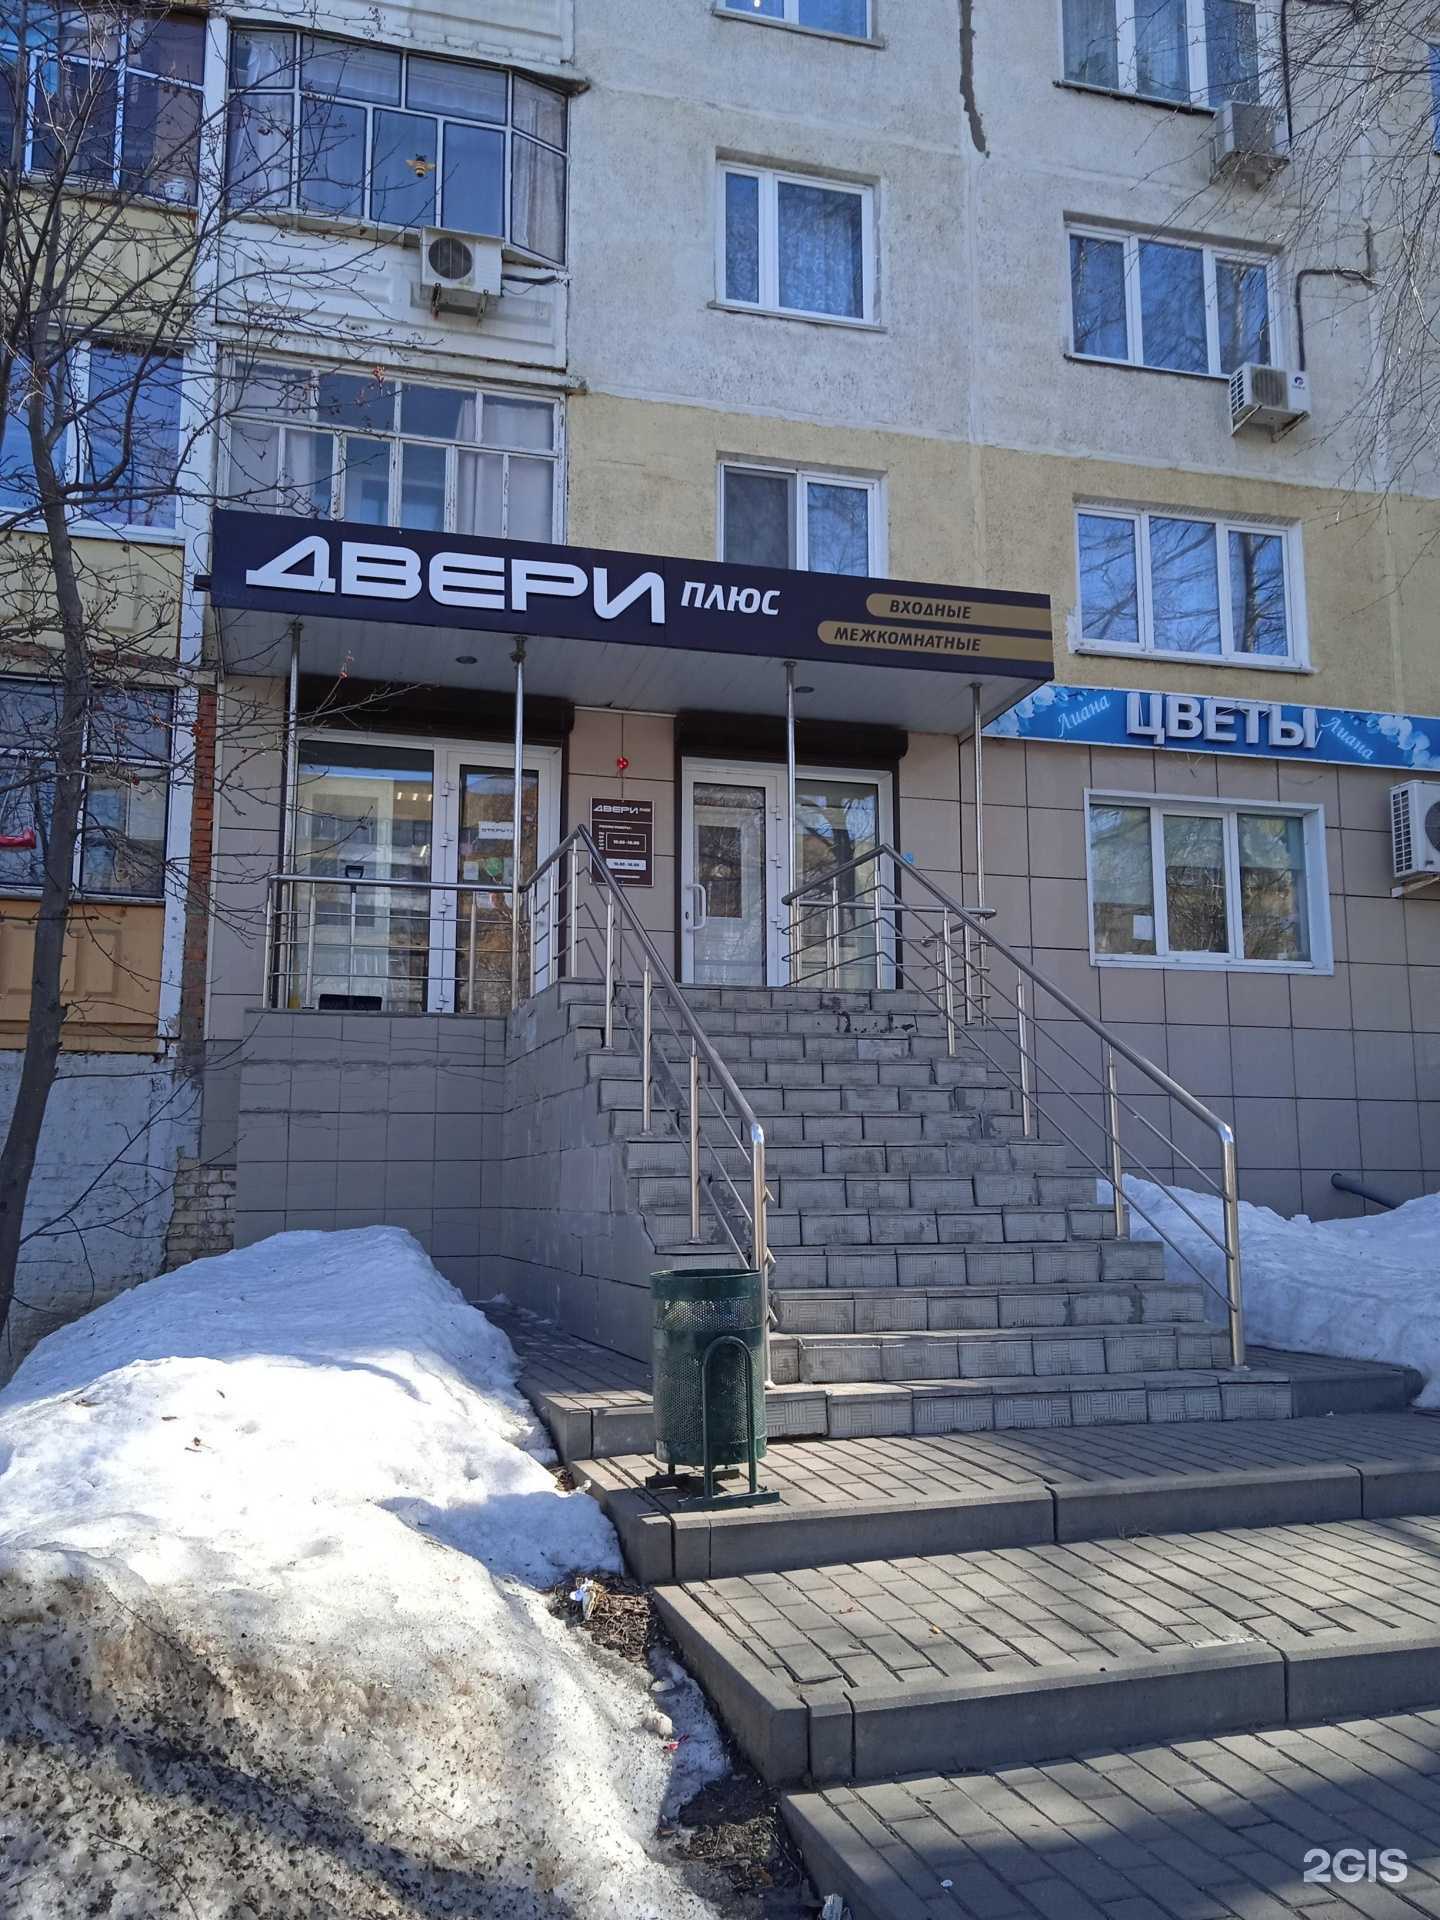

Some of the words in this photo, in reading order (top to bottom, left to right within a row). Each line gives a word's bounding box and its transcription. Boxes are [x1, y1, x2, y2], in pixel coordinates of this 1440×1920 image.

[245, 535, 667, 624] ДВЕРИ
[680, 581, 781, 616] ПЛЮС
[889, 599, 972, 620] ВХОДНЫЕ
[834, 626, 982, 652] МЕЖКОМНАТНЫЕ
[1057, 695, 1110, 737] Лиана
[1127, 692, 1318, 749] ЦВЕТЫ
[1321, 717, 1375, 760] Лиана
[593, 804, 639, 815] ДВЕРИ
